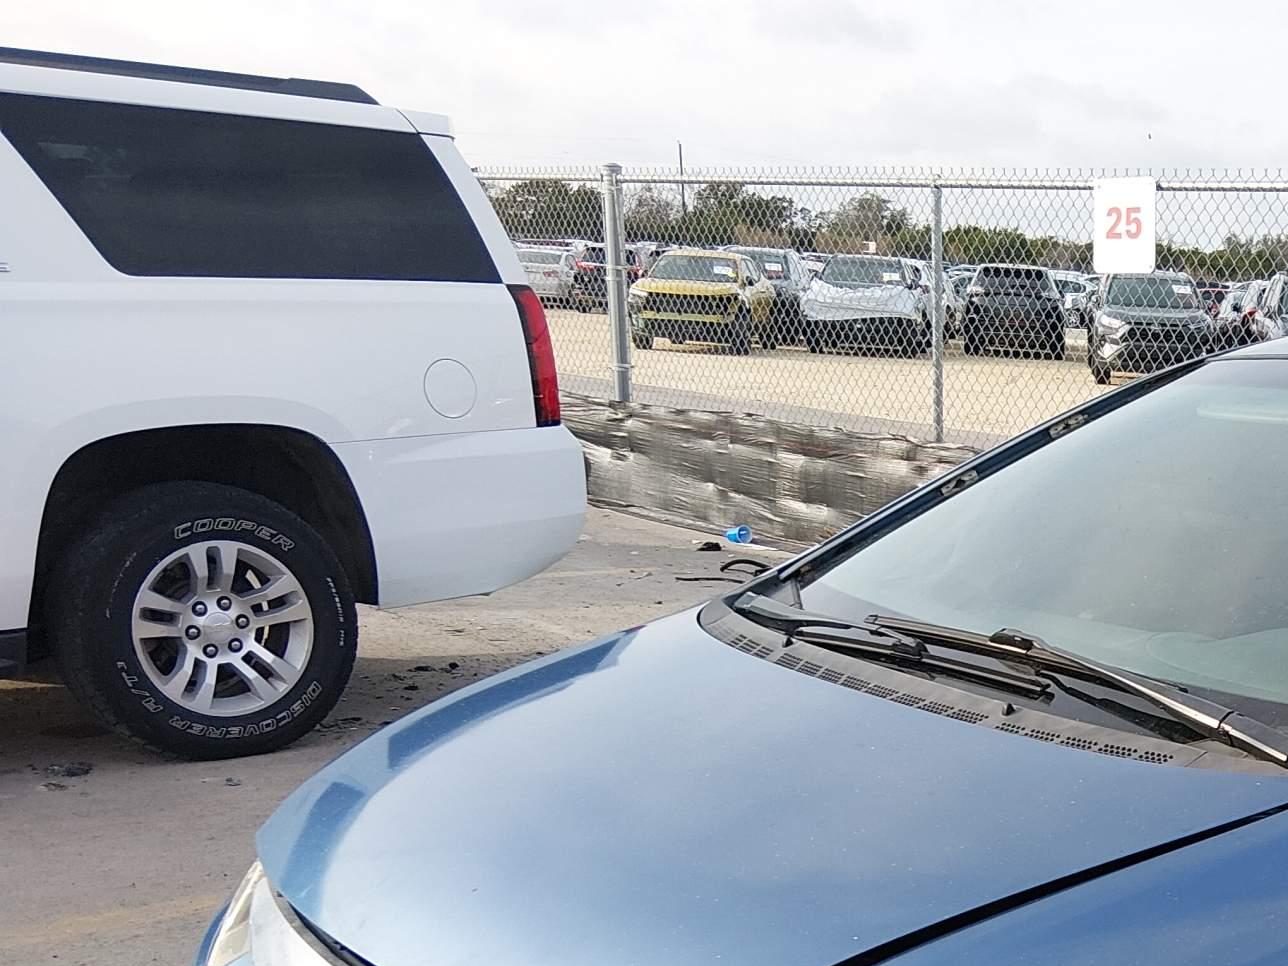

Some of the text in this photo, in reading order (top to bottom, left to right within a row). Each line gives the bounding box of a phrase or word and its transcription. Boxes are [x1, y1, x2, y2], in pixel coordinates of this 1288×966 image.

[1105, 206, 1142, 240] 25
[174, 517, 296, 551] COOPER
[168, 681, 323, 738] DISCOVERER
